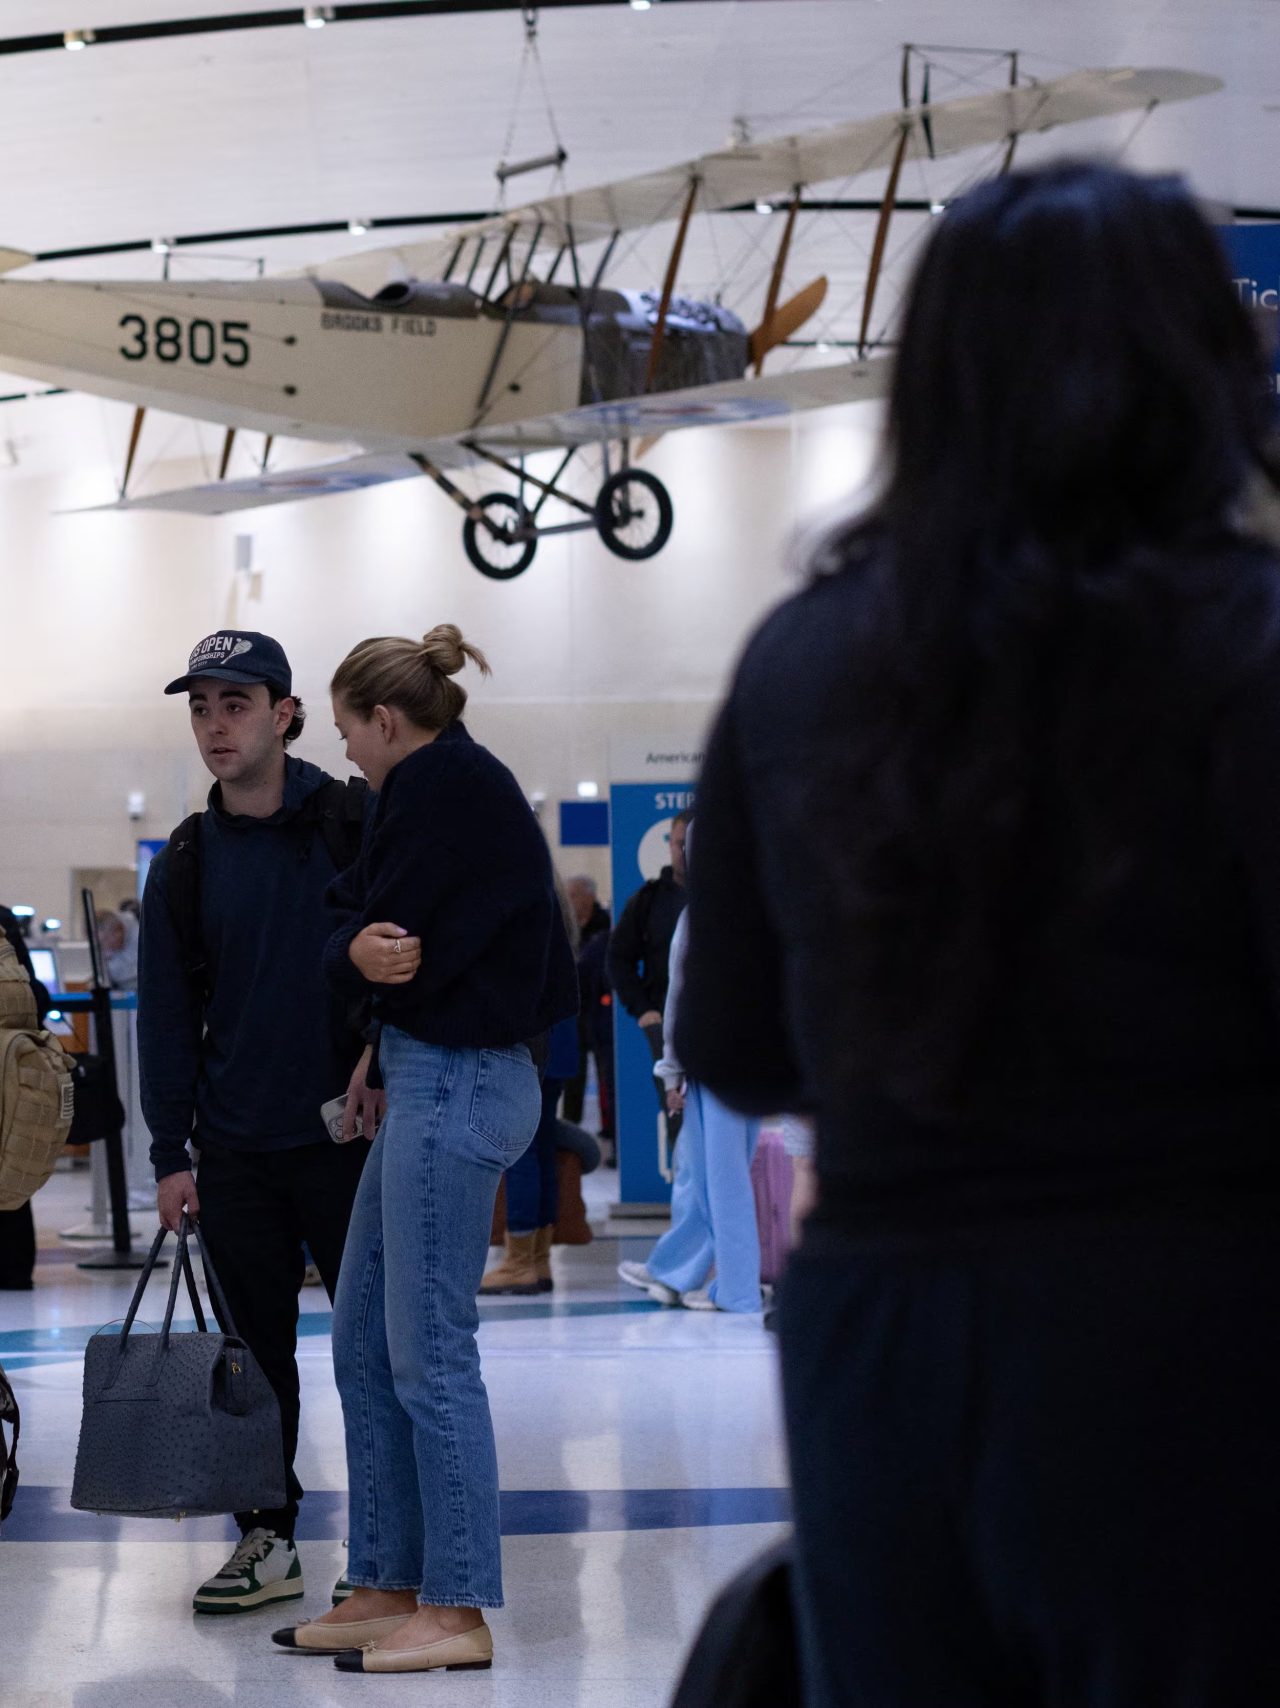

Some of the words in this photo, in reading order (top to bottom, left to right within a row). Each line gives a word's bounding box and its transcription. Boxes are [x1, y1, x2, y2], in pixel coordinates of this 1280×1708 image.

[1232, 278, 1280, 311] Tic
[320, 311, 383, 333] BROOKS
[391, 316, 437, 337] FIELD
[119, 313, 250, 368] 3805
[201, 636, 233, 654] OPEN
